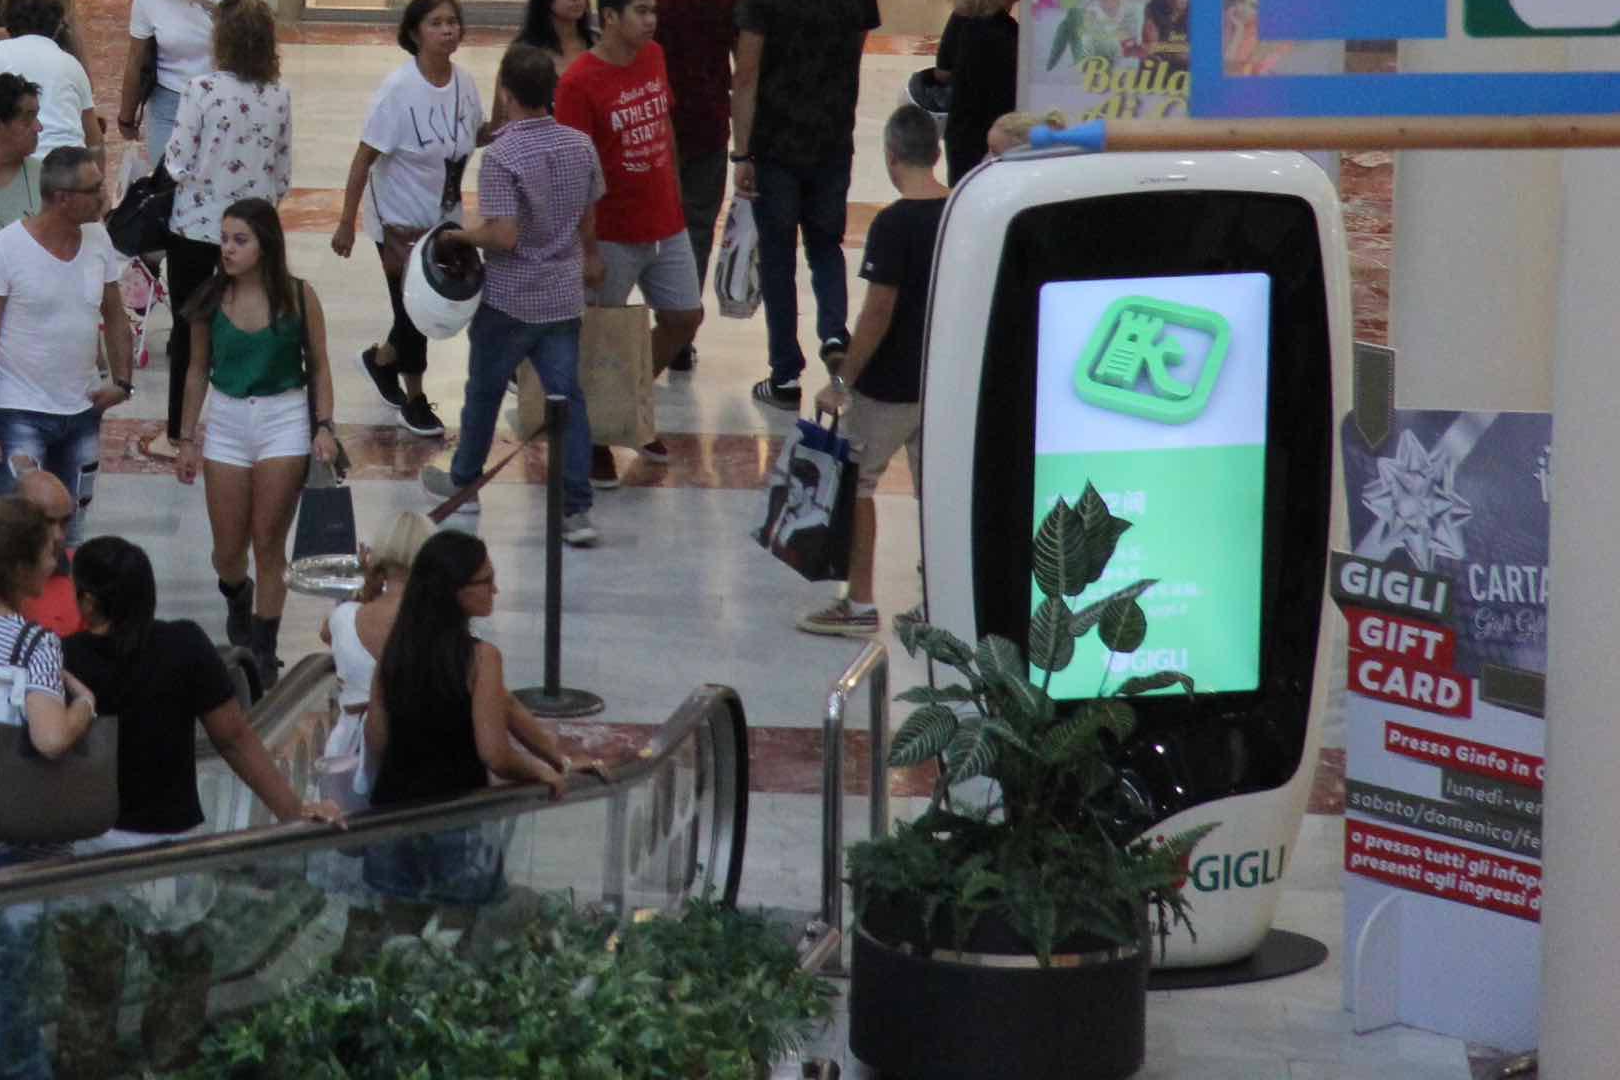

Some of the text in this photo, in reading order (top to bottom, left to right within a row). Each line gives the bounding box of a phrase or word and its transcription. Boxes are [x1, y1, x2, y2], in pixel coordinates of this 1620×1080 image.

[1340, 561, 1448, 613] GIGLI
[1132, 648, 1188, 670] GIGLI
[1359, 617, 1445, 660] GIFT
[1358, 660, 1462, 709] CARD
[1388, 729, 1451, 758] Presso
[1455, 745, 1508, 771] Ginfo
[1511, 757, 1530, 776] in
[1192, 844, 1286, 892] GIGLI
[1364, 833, 1421, 858] presso
[1424, 845, 1465, 869] tutti
[1468, 857, 1490, 876] gli
[1350, 852, 1421, 881] presenti
[1423, 869, 1457, 891] agli
[1459, 875, 1527, 906] ingressi
